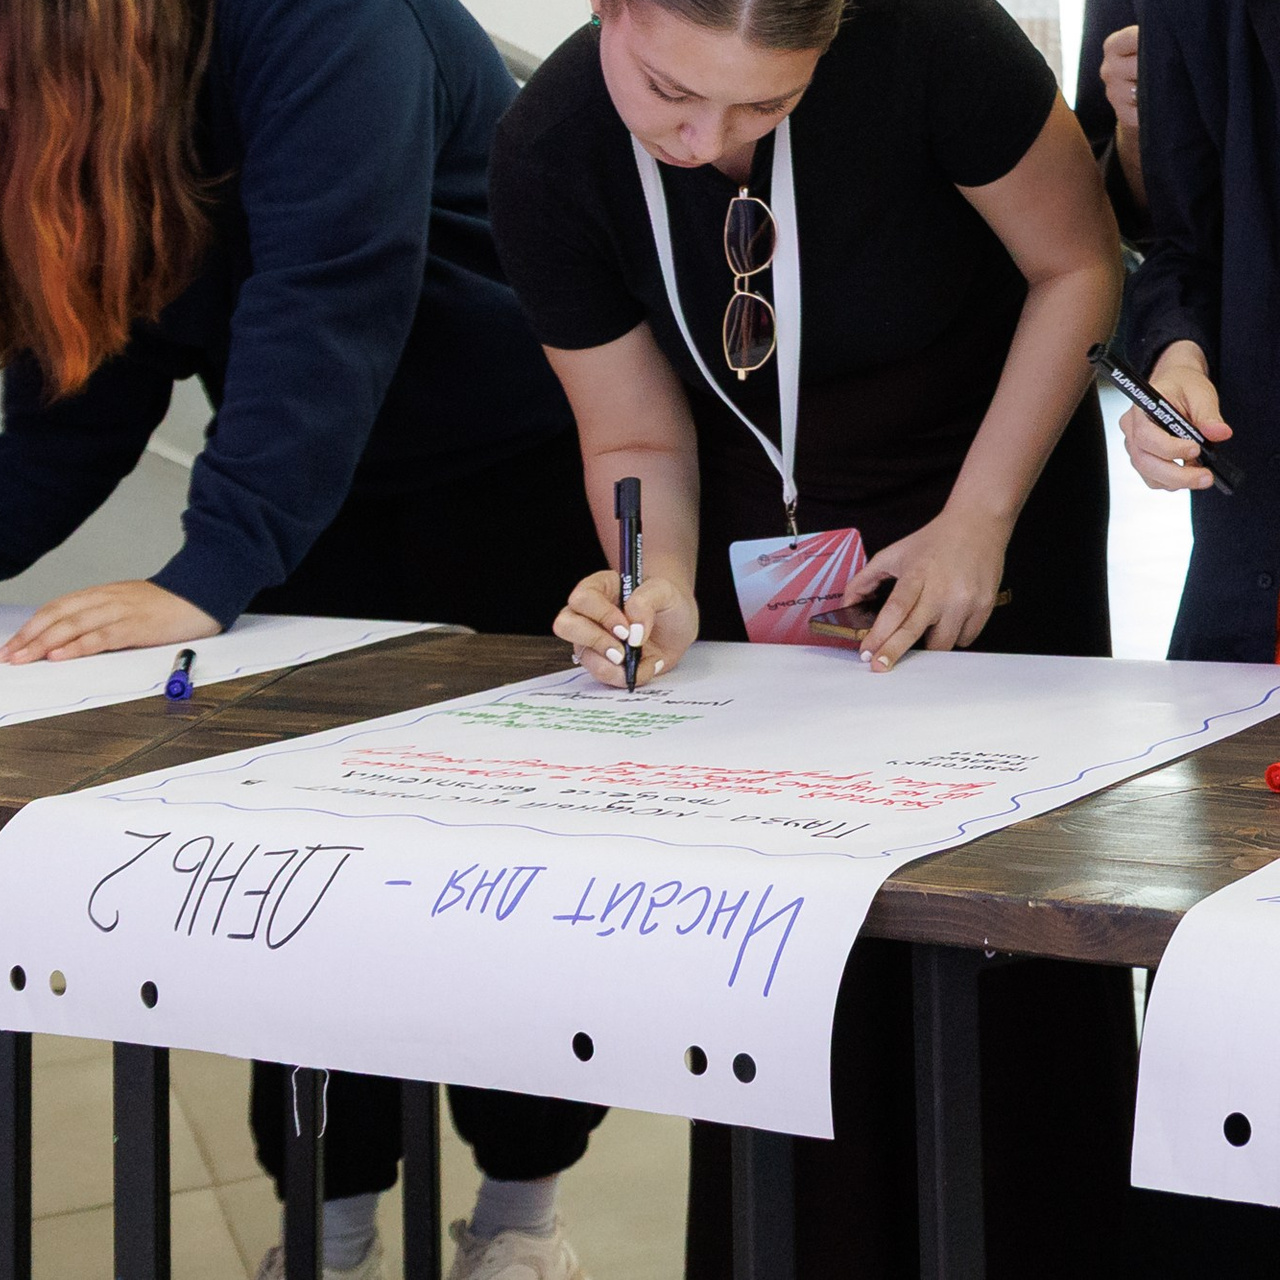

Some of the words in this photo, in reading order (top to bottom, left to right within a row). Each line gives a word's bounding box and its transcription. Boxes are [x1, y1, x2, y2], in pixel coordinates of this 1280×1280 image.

[87, 830, 172, 935] 2
[172, 835, 366, 951] ДЕНЬ
[432, 863, 549, 923] дня
[553, 877, 806, 999] Инсайт
